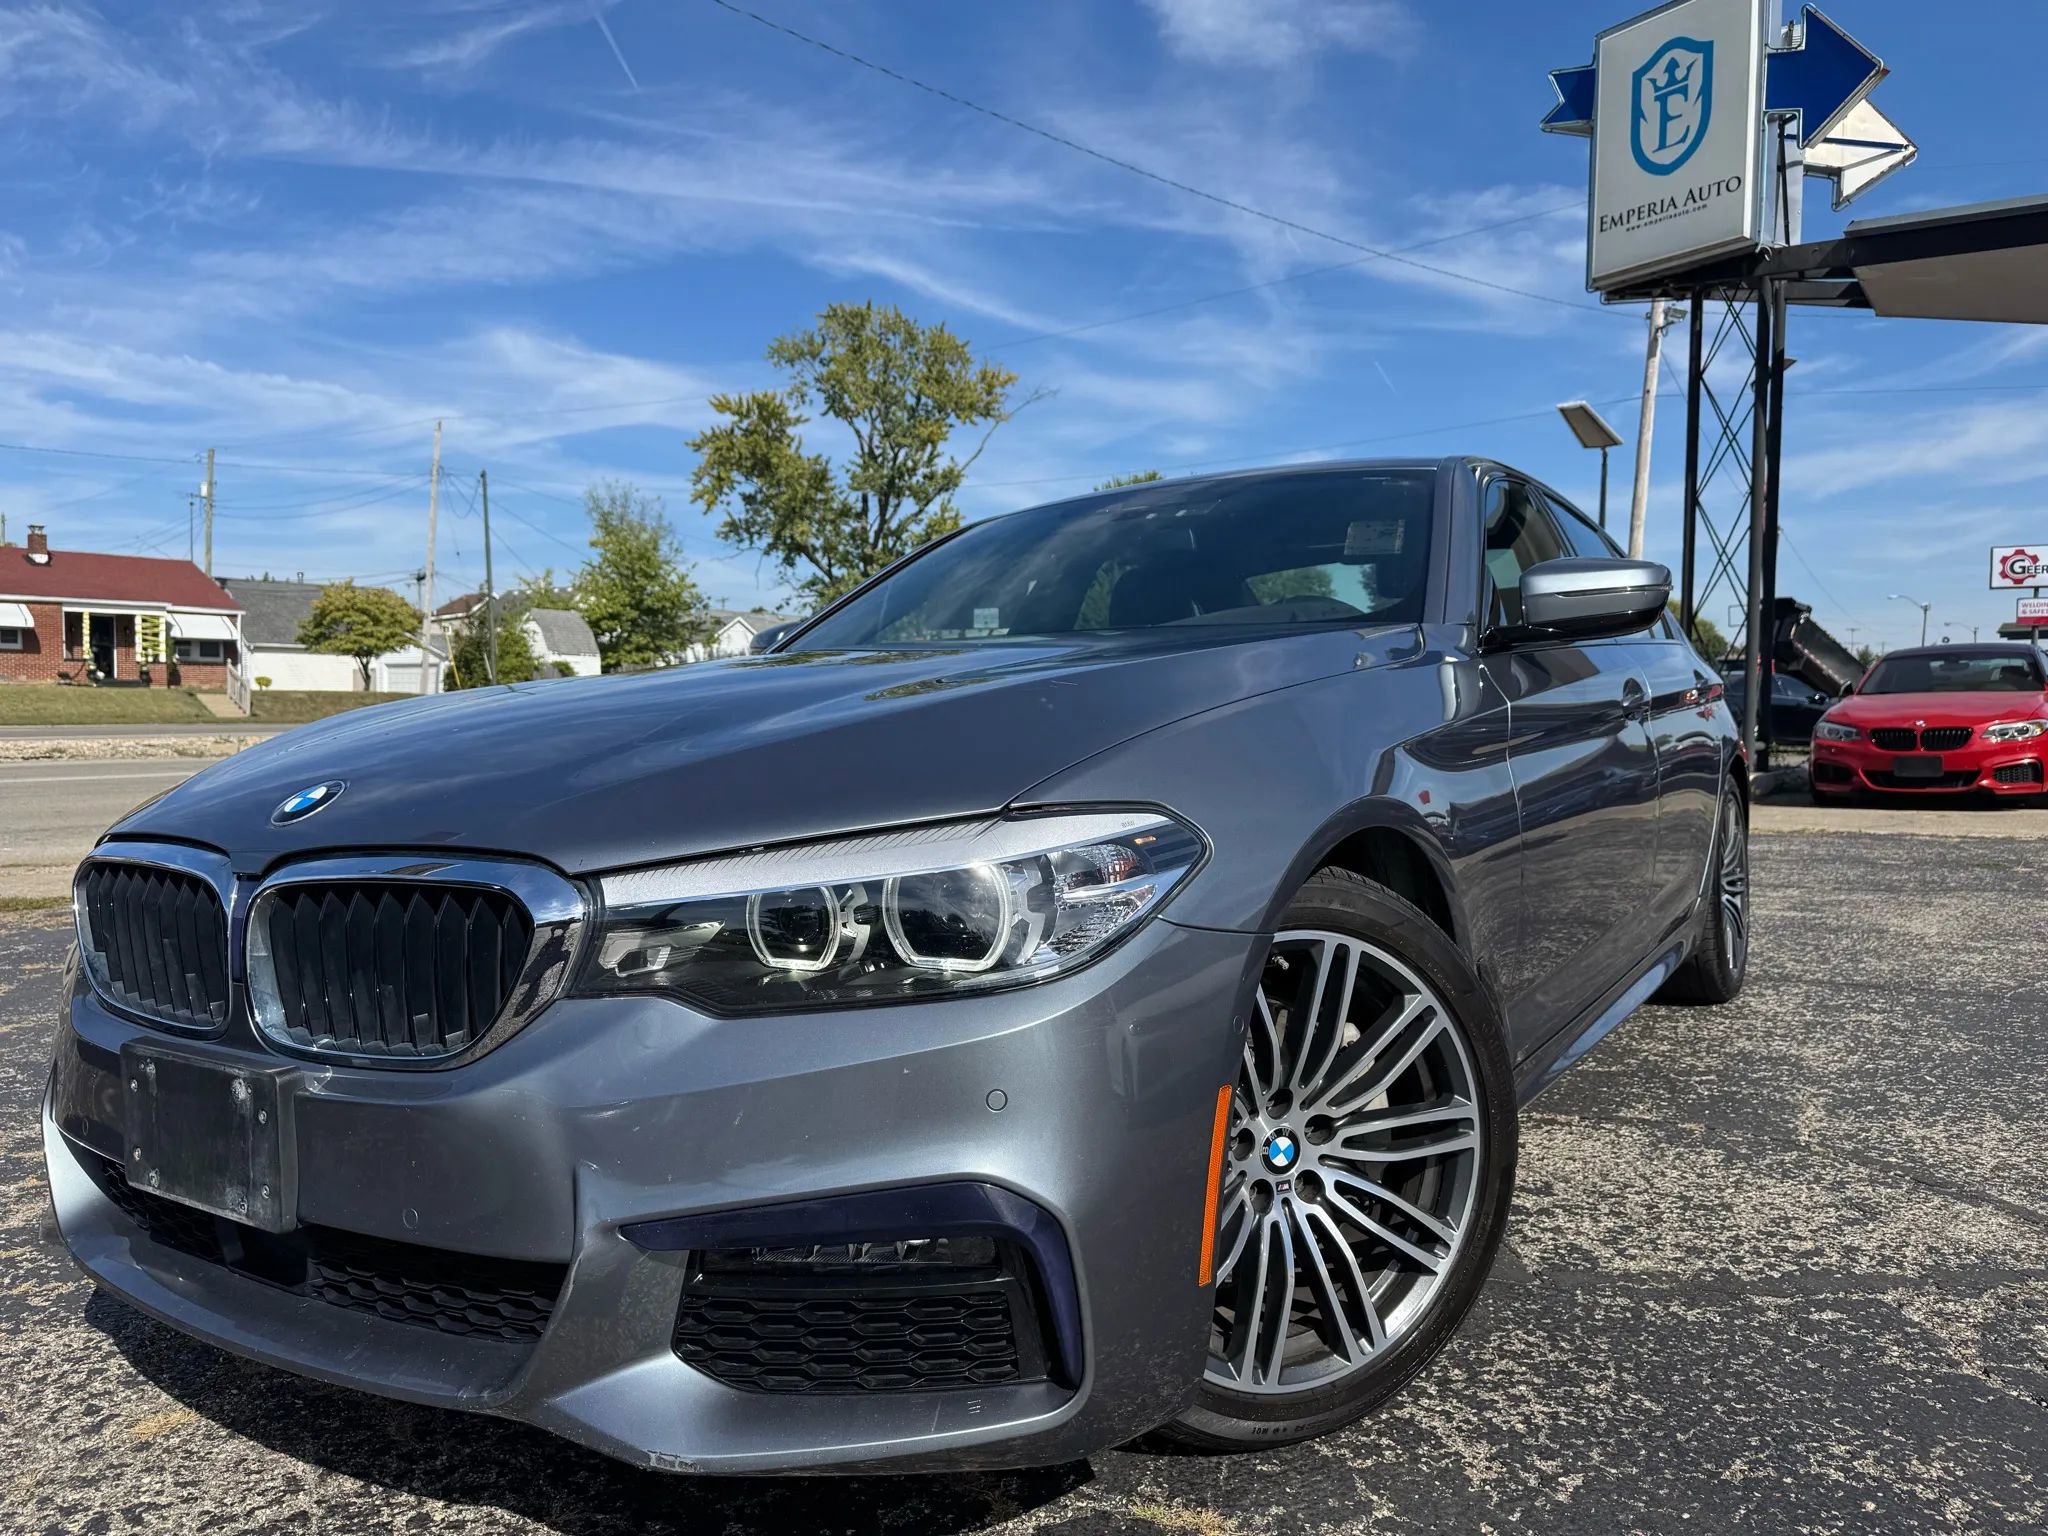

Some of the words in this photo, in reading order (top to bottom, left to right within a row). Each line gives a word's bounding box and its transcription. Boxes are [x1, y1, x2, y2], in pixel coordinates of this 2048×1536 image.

[1599, 196, 1678, 233] EMPERIA
[1683, 175, 1742, 207] AUTO
[1262, 1127, 1290, 1155] BMW
